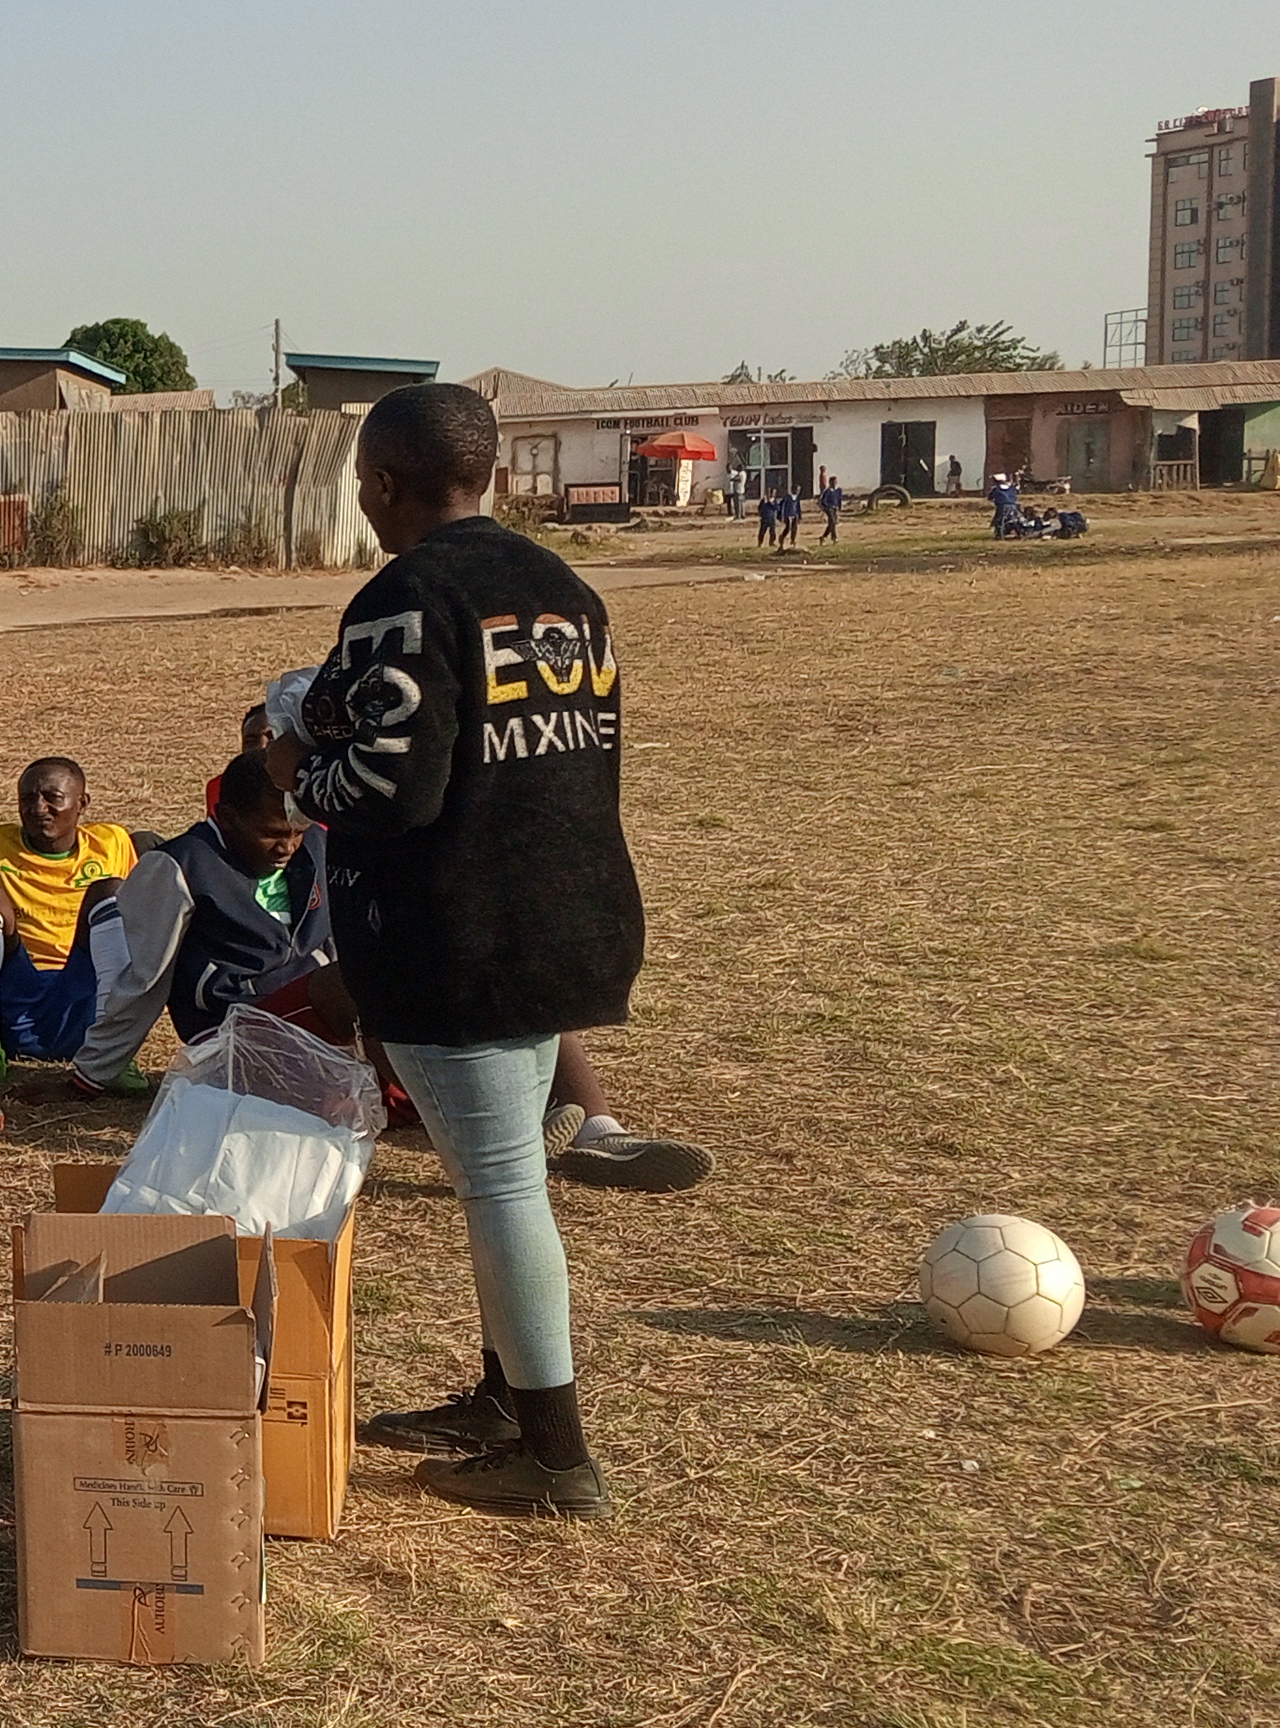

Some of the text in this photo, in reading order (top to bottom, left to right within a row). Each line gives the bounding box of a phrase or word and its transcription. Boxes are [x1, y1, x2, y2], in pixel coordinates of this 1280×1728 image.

[623, 417, 671, 429] FOOTBALL
[674, 416, 699, 427] CLUB
[114, 1344, 123, 1357] P
[125, 1344, 172, 1358] 2000649
[79, 1480, 117, 1491] Medicines
[167, 1484, 186, 1494] Care
[110, 1497, 130, 1508] This
[132, 1498, 152, 1509] Side
